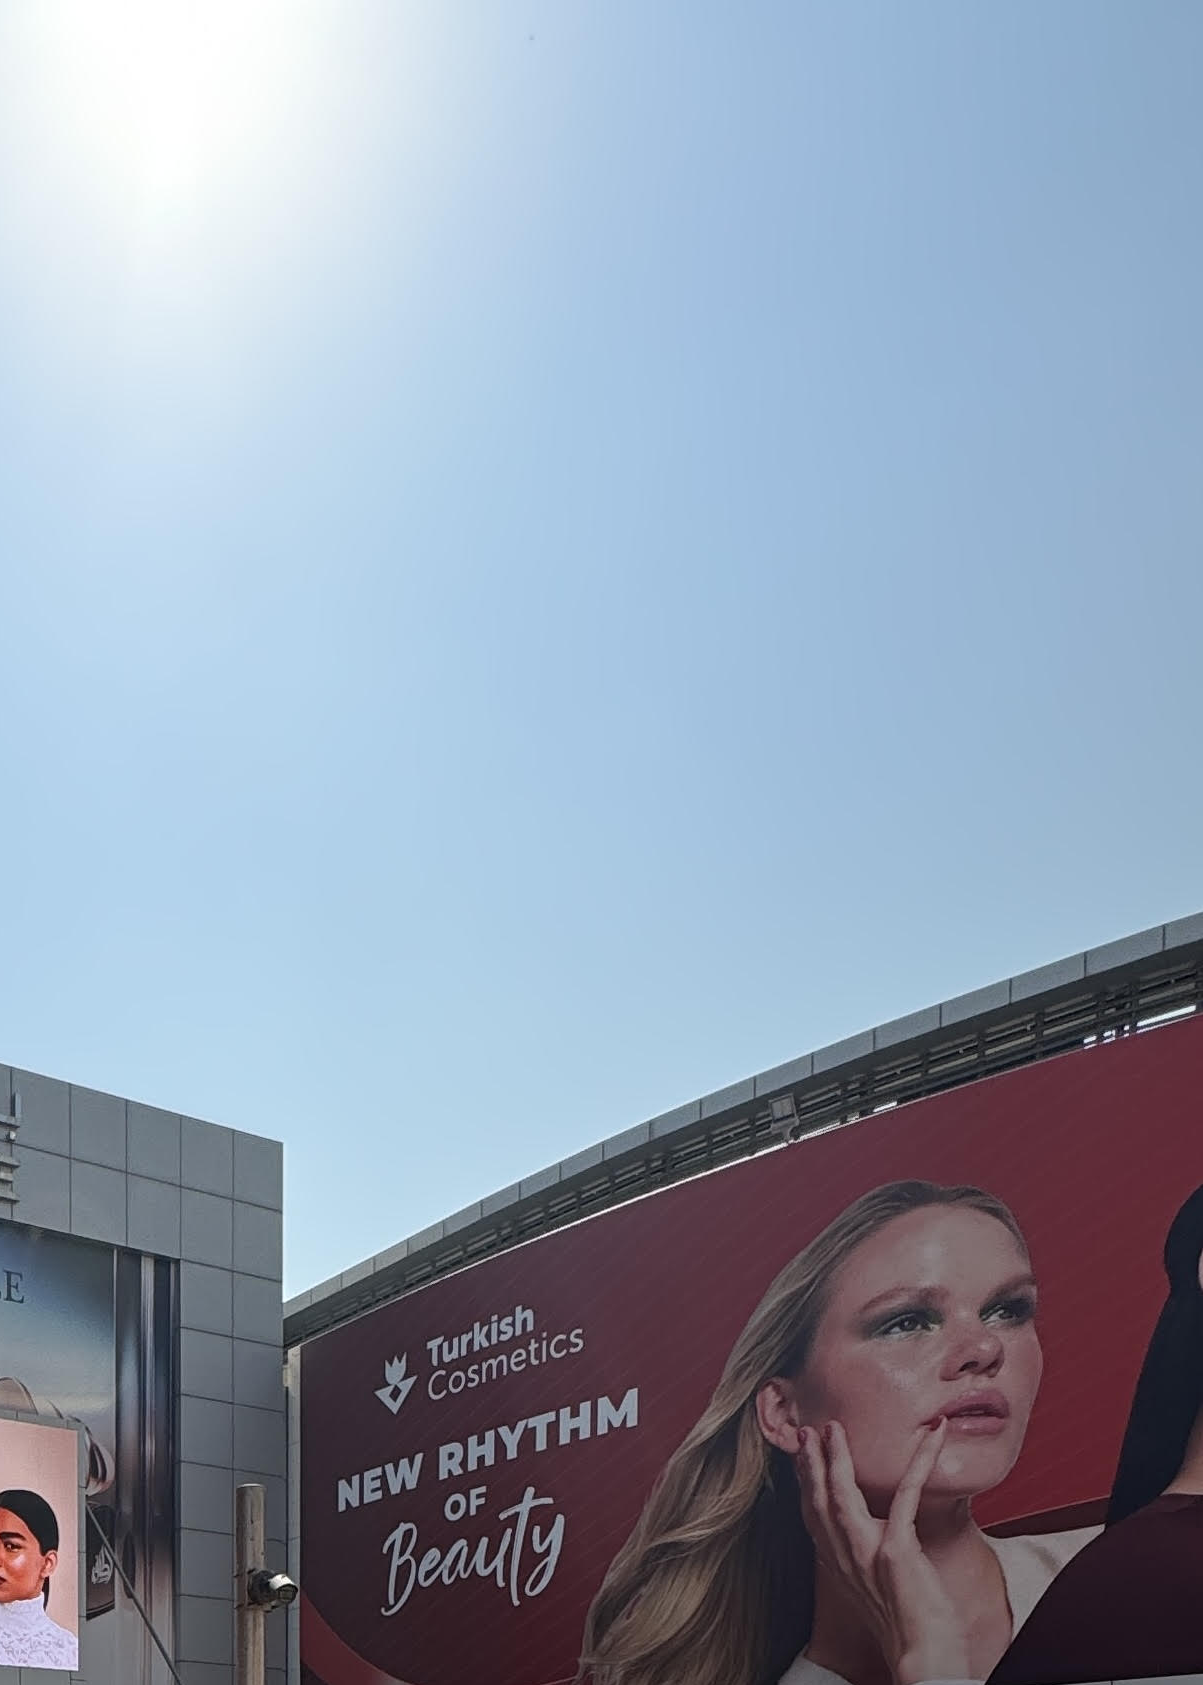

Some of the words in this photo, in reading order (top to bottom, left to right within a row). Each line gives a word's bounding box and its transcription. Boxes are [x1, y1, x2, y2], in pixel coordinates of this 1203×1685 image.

[425, 1303, 536, 1369] Turkish
[426, 1327, 586, 1402] Cosmetics
[336, 1452, 424, 1513] NEW
[438, 1387, 640, 1481] RHYTHM
[443, 1485, 488, 1522] OF
[380, 1485, 567, 1618] Beauty
